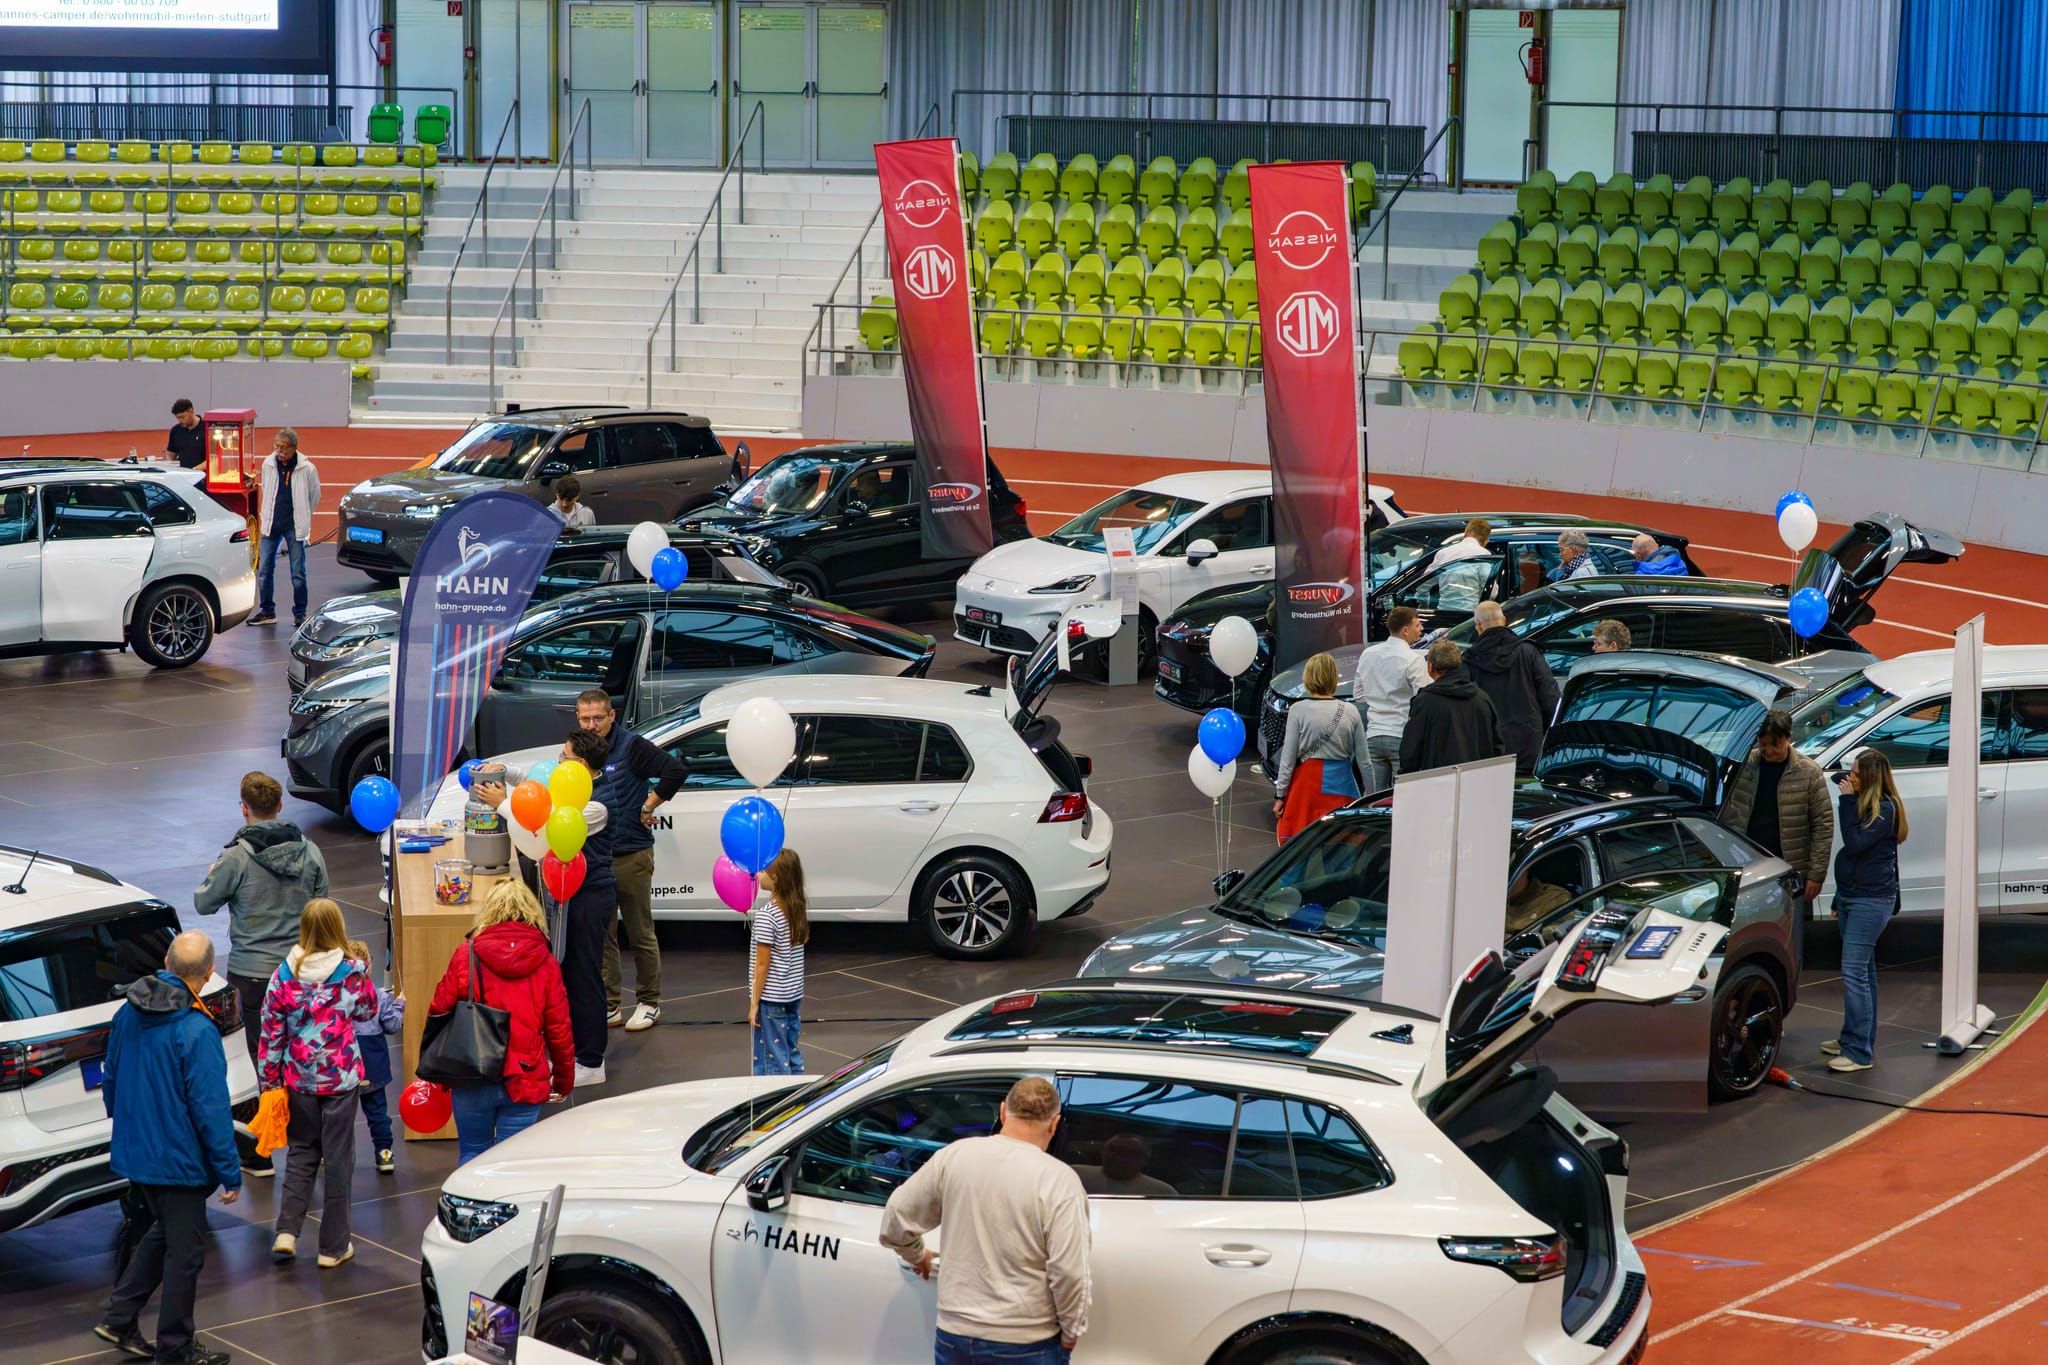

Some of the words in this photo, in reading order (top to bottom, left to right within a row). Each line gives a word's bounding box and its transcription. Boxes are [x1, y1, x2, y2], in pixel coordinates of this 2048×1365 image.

[436, 575, 509, 595] HAHN
[435, 602, 507, 613] hahn-gruppe.de
[764, 1225, 840, 1260] HAHN
[1832, 1317, 1859, 1326] 4
[1880, 1323, 1949, 1338] 200
